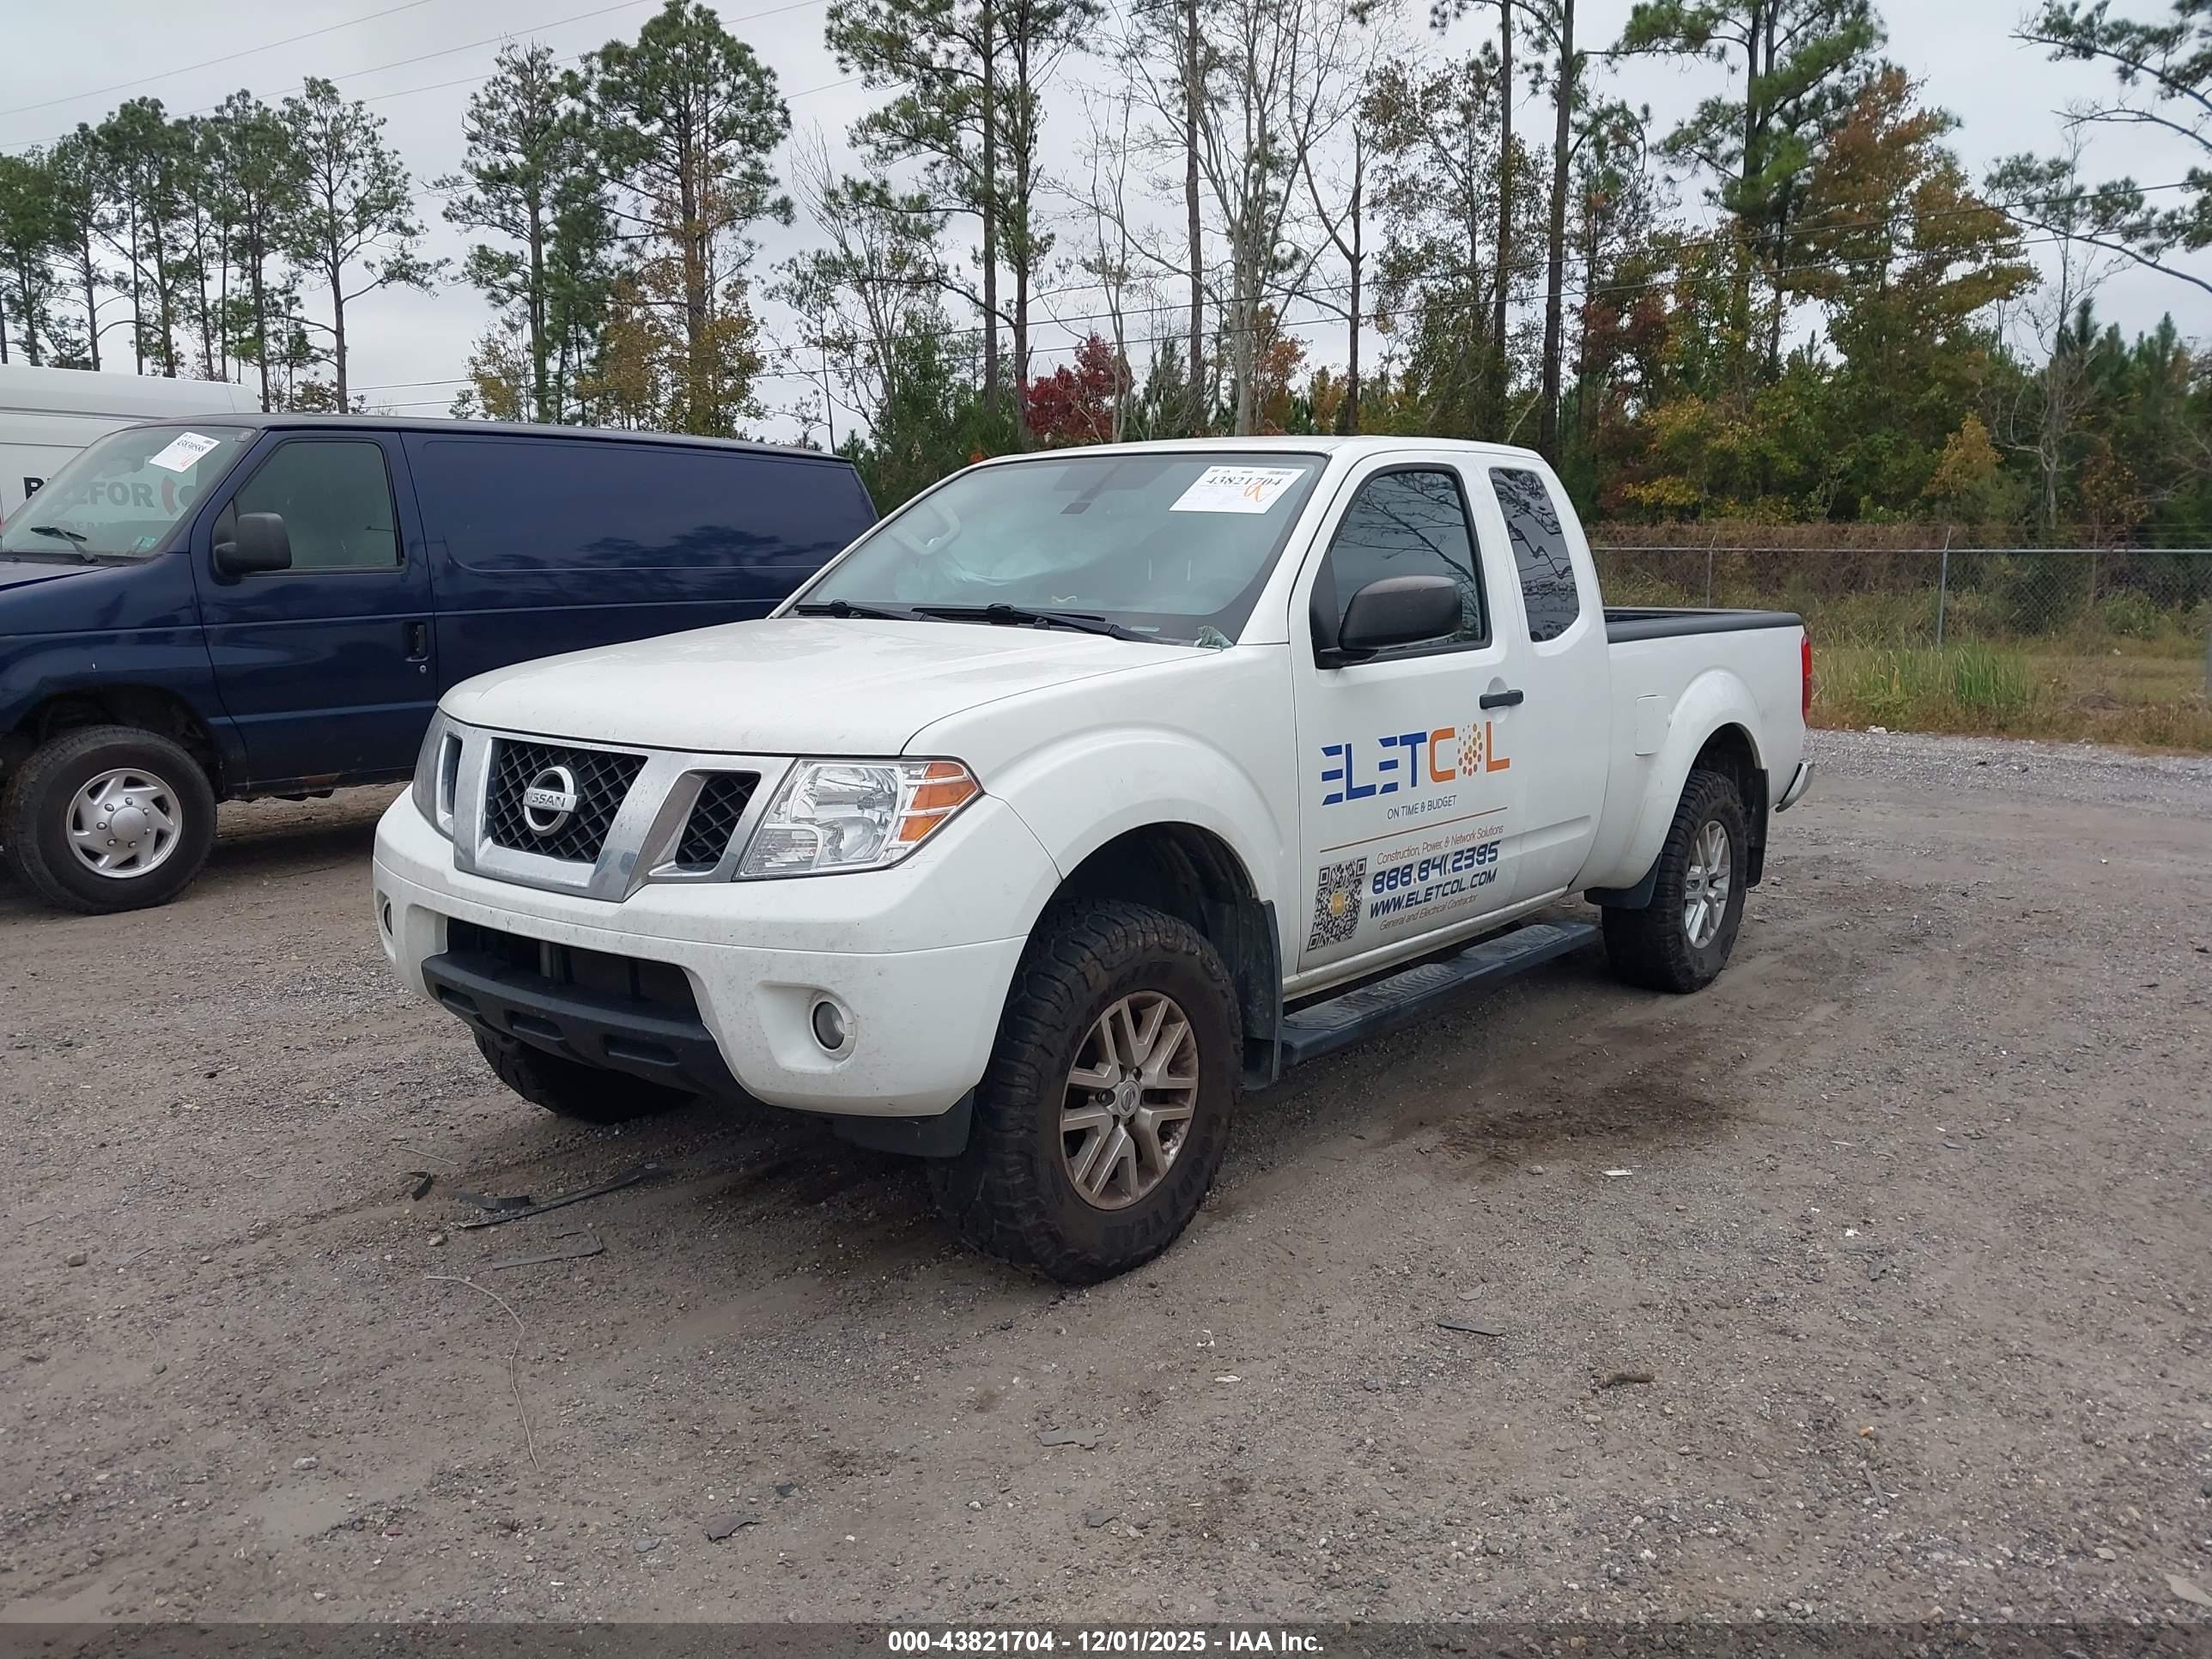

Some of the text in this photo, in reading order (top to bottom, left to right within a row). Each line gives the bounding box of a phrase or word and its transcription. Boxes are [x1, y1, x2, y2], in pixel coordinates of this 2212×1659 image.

[1387, 794, 1457, 820] ON TIME & BUDGET
[1444, 836, 1450, 848] &
[1450, 830, 1477, 846] Network
[1476, 824, 1504, 840] Solutions
[1371, 840, 1502, 895] 888.841.2395
[1369, 867, 1498, 919] WWW.ELETCOL.COM
[1379, 893, 1478, 932] General and Electrical Contractor
